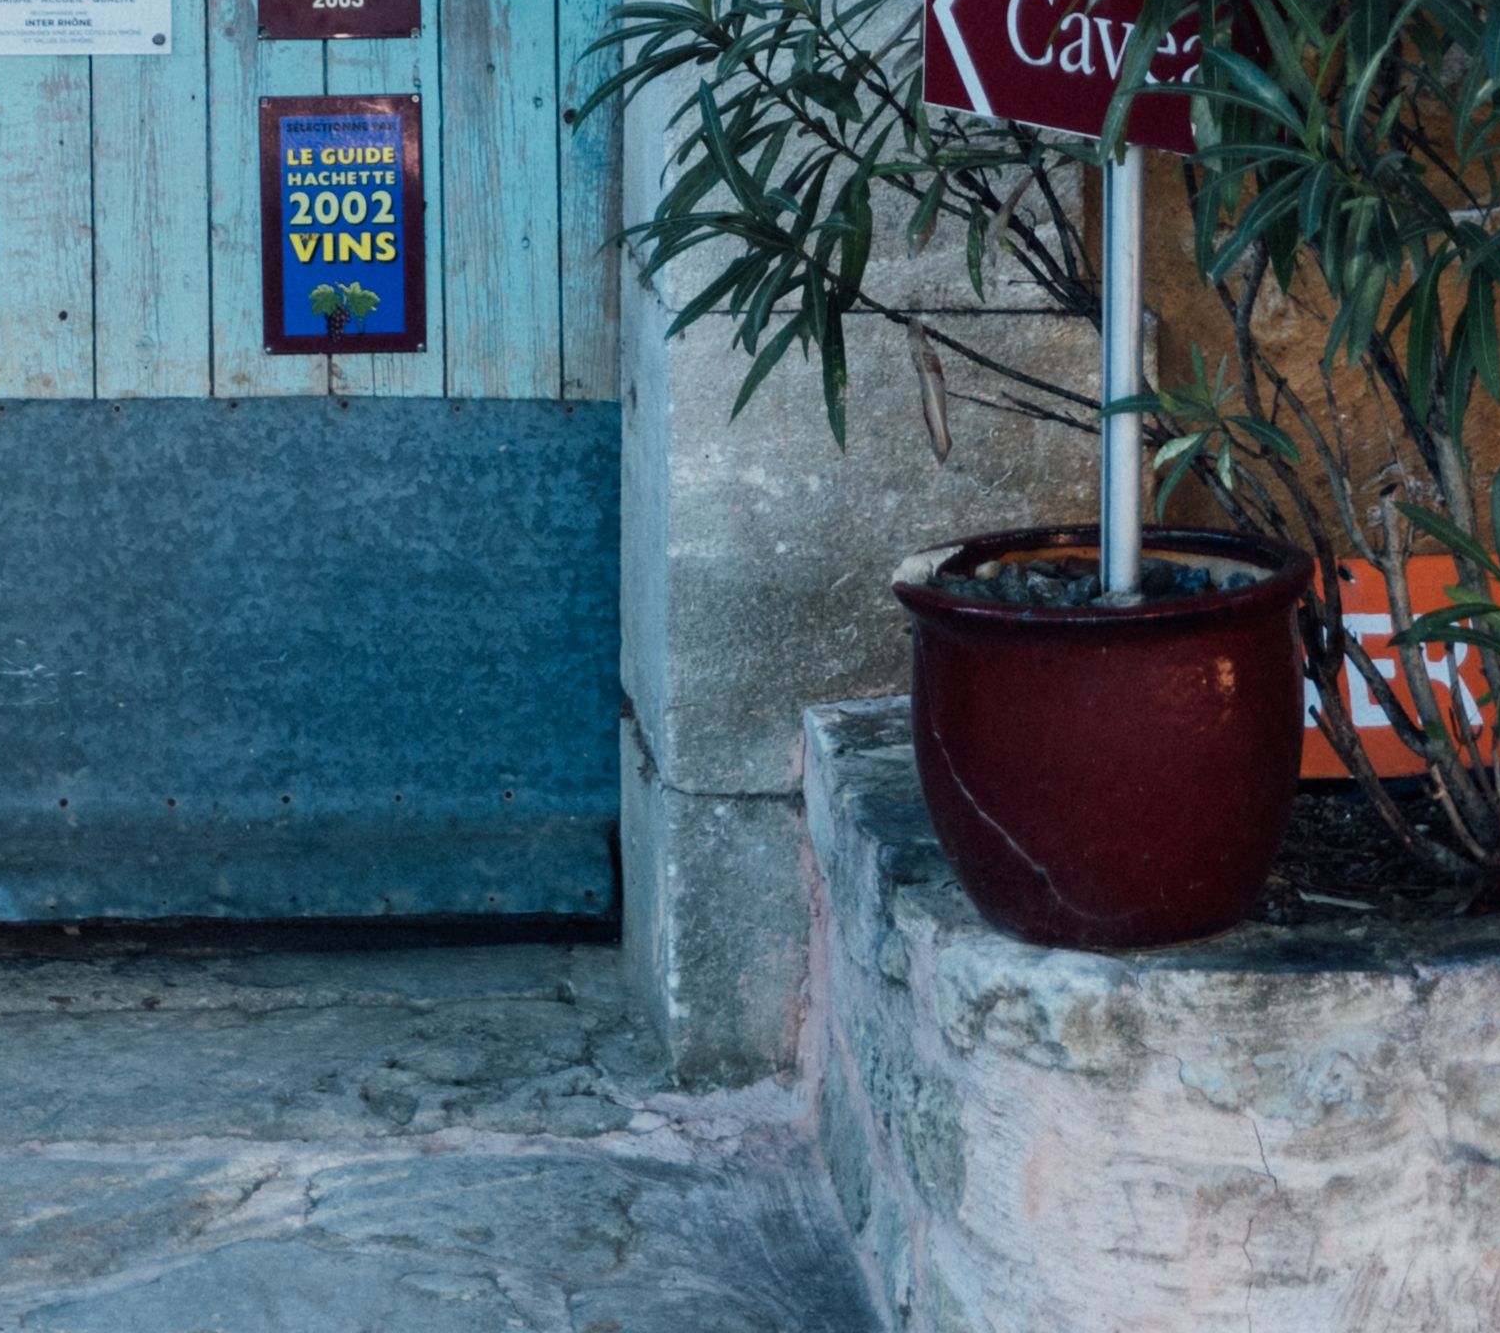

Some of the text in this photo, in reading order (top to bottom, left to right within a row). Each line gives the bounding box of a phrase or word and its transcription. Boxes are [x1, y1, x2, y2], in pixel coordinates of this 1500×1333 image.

[58, 18, 92, 26] RHÔNE
[288, 147, 394, 165] LE GUIDE
[288, 171, 395, 185] HACHETTE
[290, 191, 395, 225] 2002
[290, 232, 396, 262] VINS
